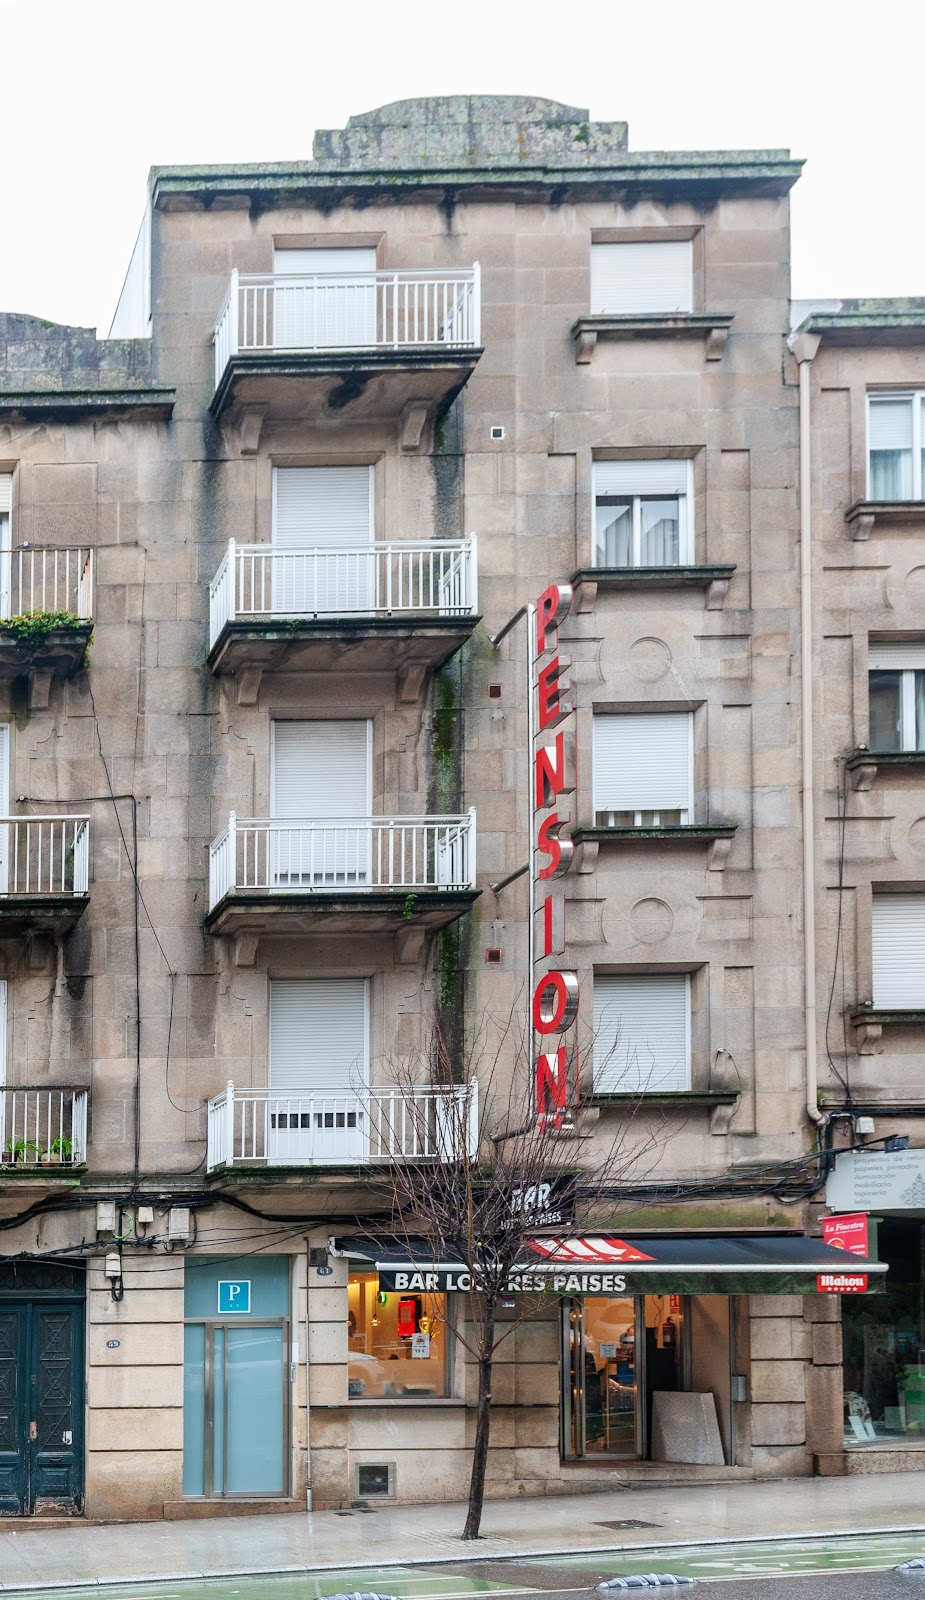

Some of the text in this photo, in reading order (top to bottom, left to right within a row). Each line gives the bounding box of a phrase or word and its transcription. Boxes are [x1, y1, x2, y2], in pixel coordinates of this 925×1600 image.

[533, 583, 570, 1114] PENSION
[854, 1157, 890, 1165] proyectos
[854, 1163, 919, 1173] papeles pintados
[511, 1183, 551, 1212] BAR
[835, 1222, 864, 1231] Finestra
[394, 1273, 439, 1290] BAR
[495, 1274, 546, 1291] RES
[553, 1275, 627, 1291] PAISES
[820, 1275, 864, 1287] Mahou
[228, 1285, 241, 1301] P
